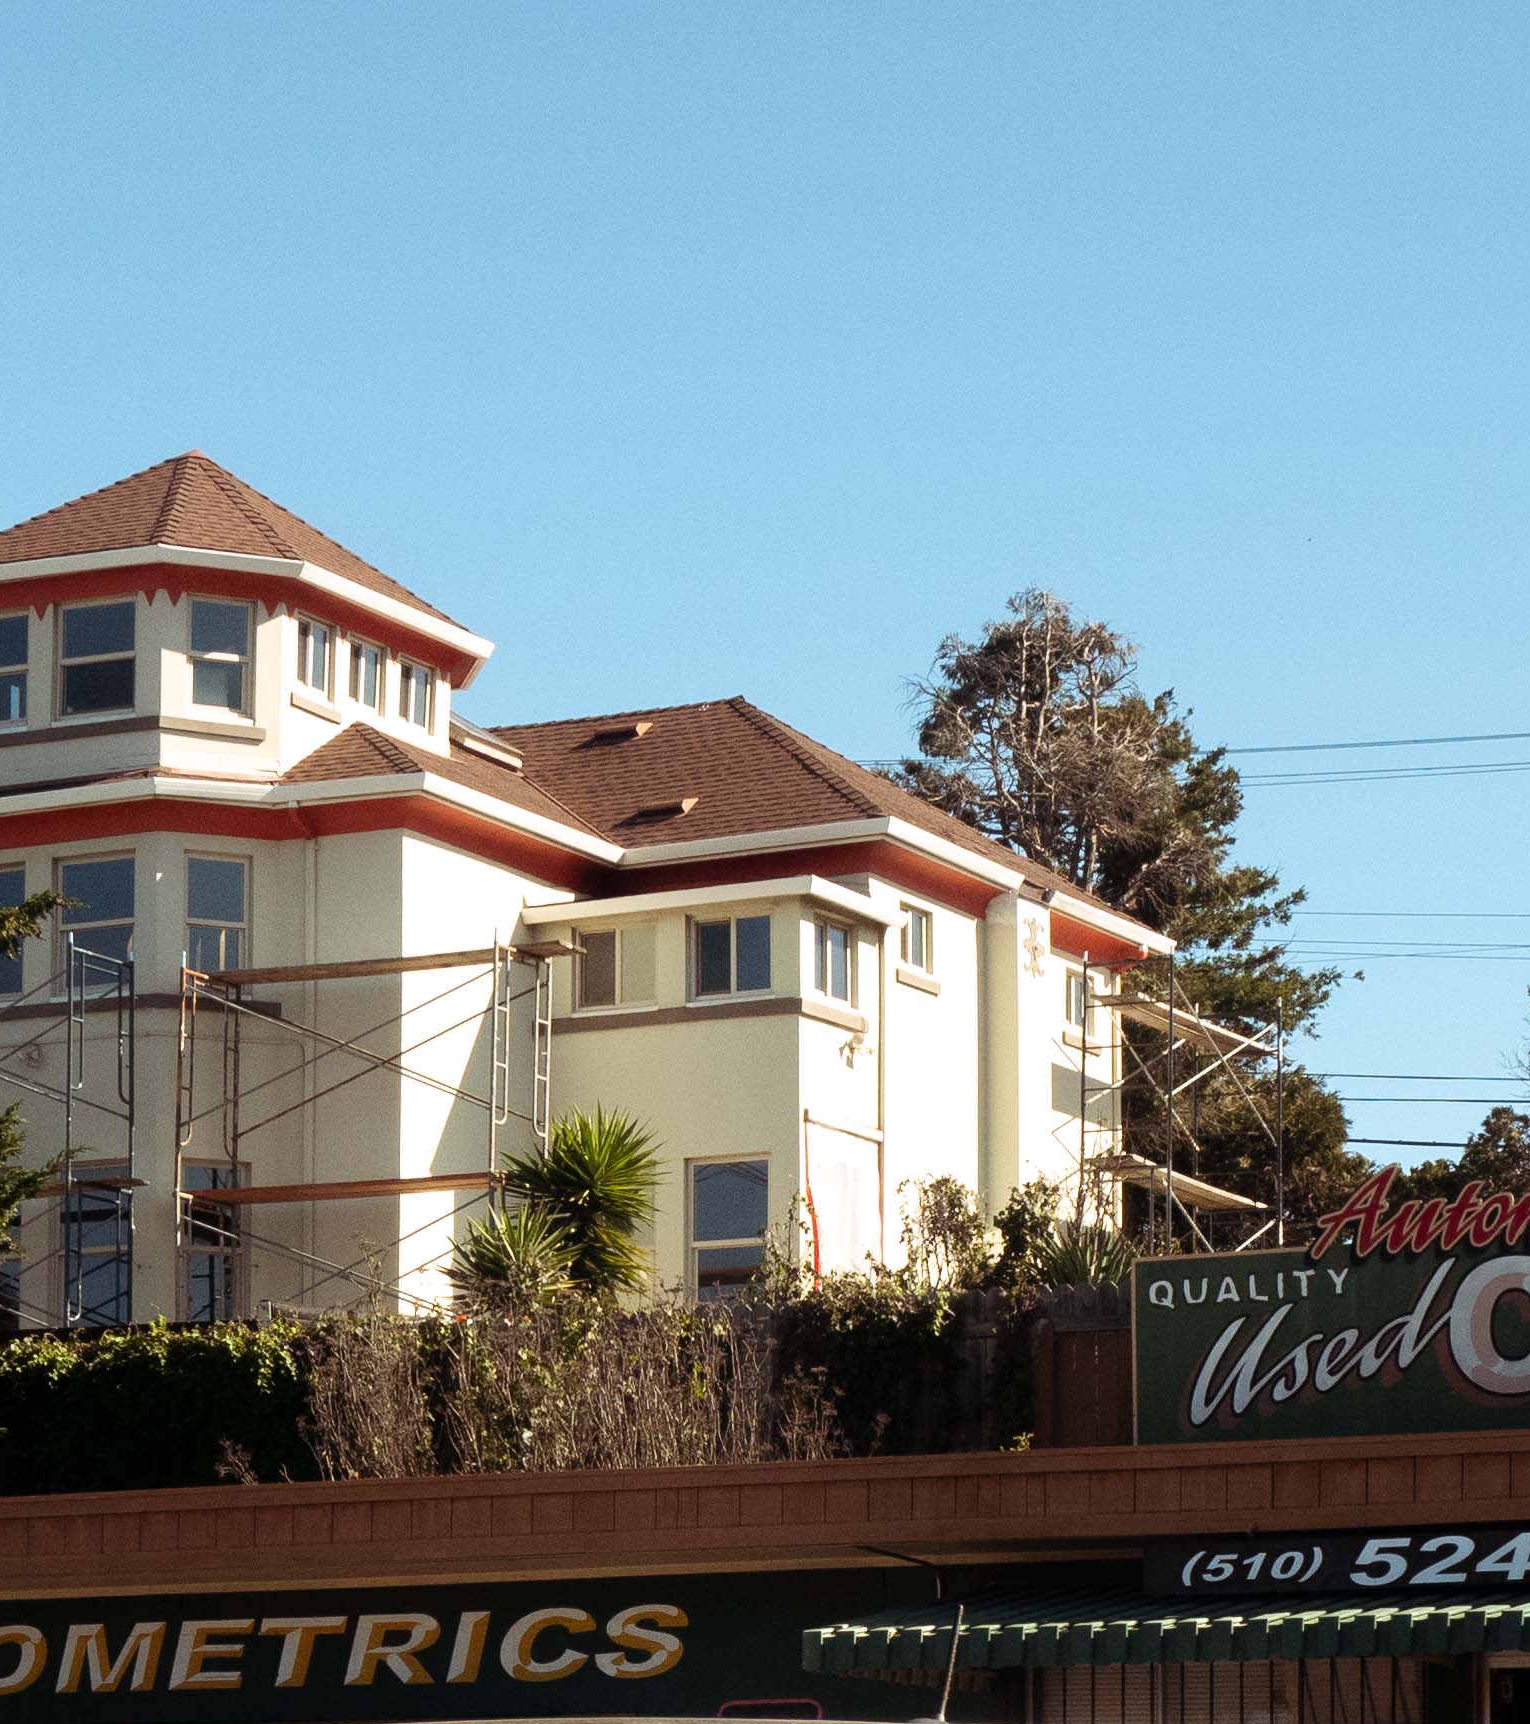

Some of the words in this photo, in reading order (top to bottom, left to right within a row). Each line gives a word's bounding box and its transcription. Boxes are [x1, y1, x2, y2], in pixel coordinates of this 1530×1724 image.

[1149, 1267, 1350, 1308] QUALITY
[1189, 1257, 1457, 1427] Used
[1182, 1546, 1325, 1587] (510)
